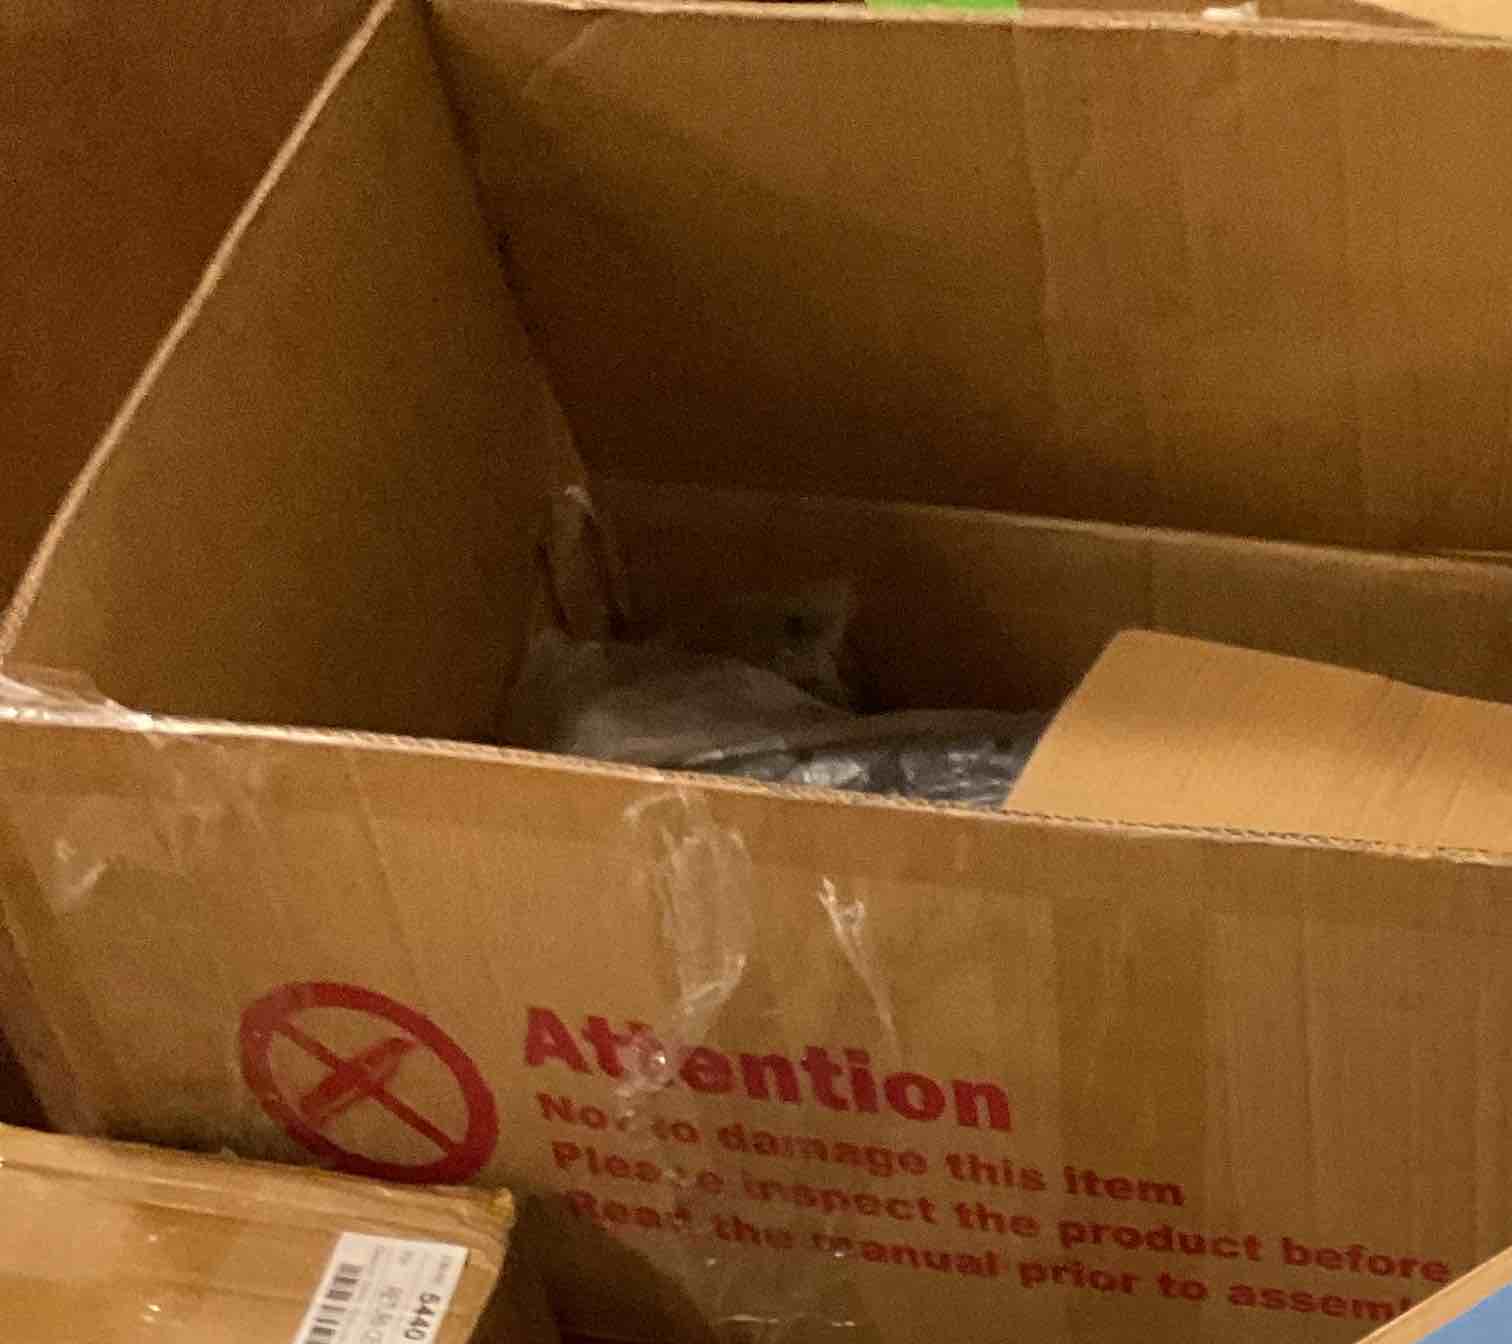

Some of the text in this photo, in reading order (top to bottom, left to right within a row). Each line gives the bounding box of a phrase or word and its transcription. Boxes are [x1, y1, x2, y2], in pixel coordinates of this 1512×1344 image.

[536, 1091, 636, 1130] No
[716, 1122, 928, 1178] damage
[945, 1153, 1047, 1192] this
[1062, 1165, 1185, 1206] item
[740, 1168, 938, 1226] inspect
[954, 1201, 1041, 1237] the
[1056, 1219, 1263, 1263] product
[1279, 1236, 1450, 1283] before
[1016, 1260, 1140, 1294] prior
[1155, 1268, 1208, 1301] to
[1229, 1283, 1419, 1321] assem
